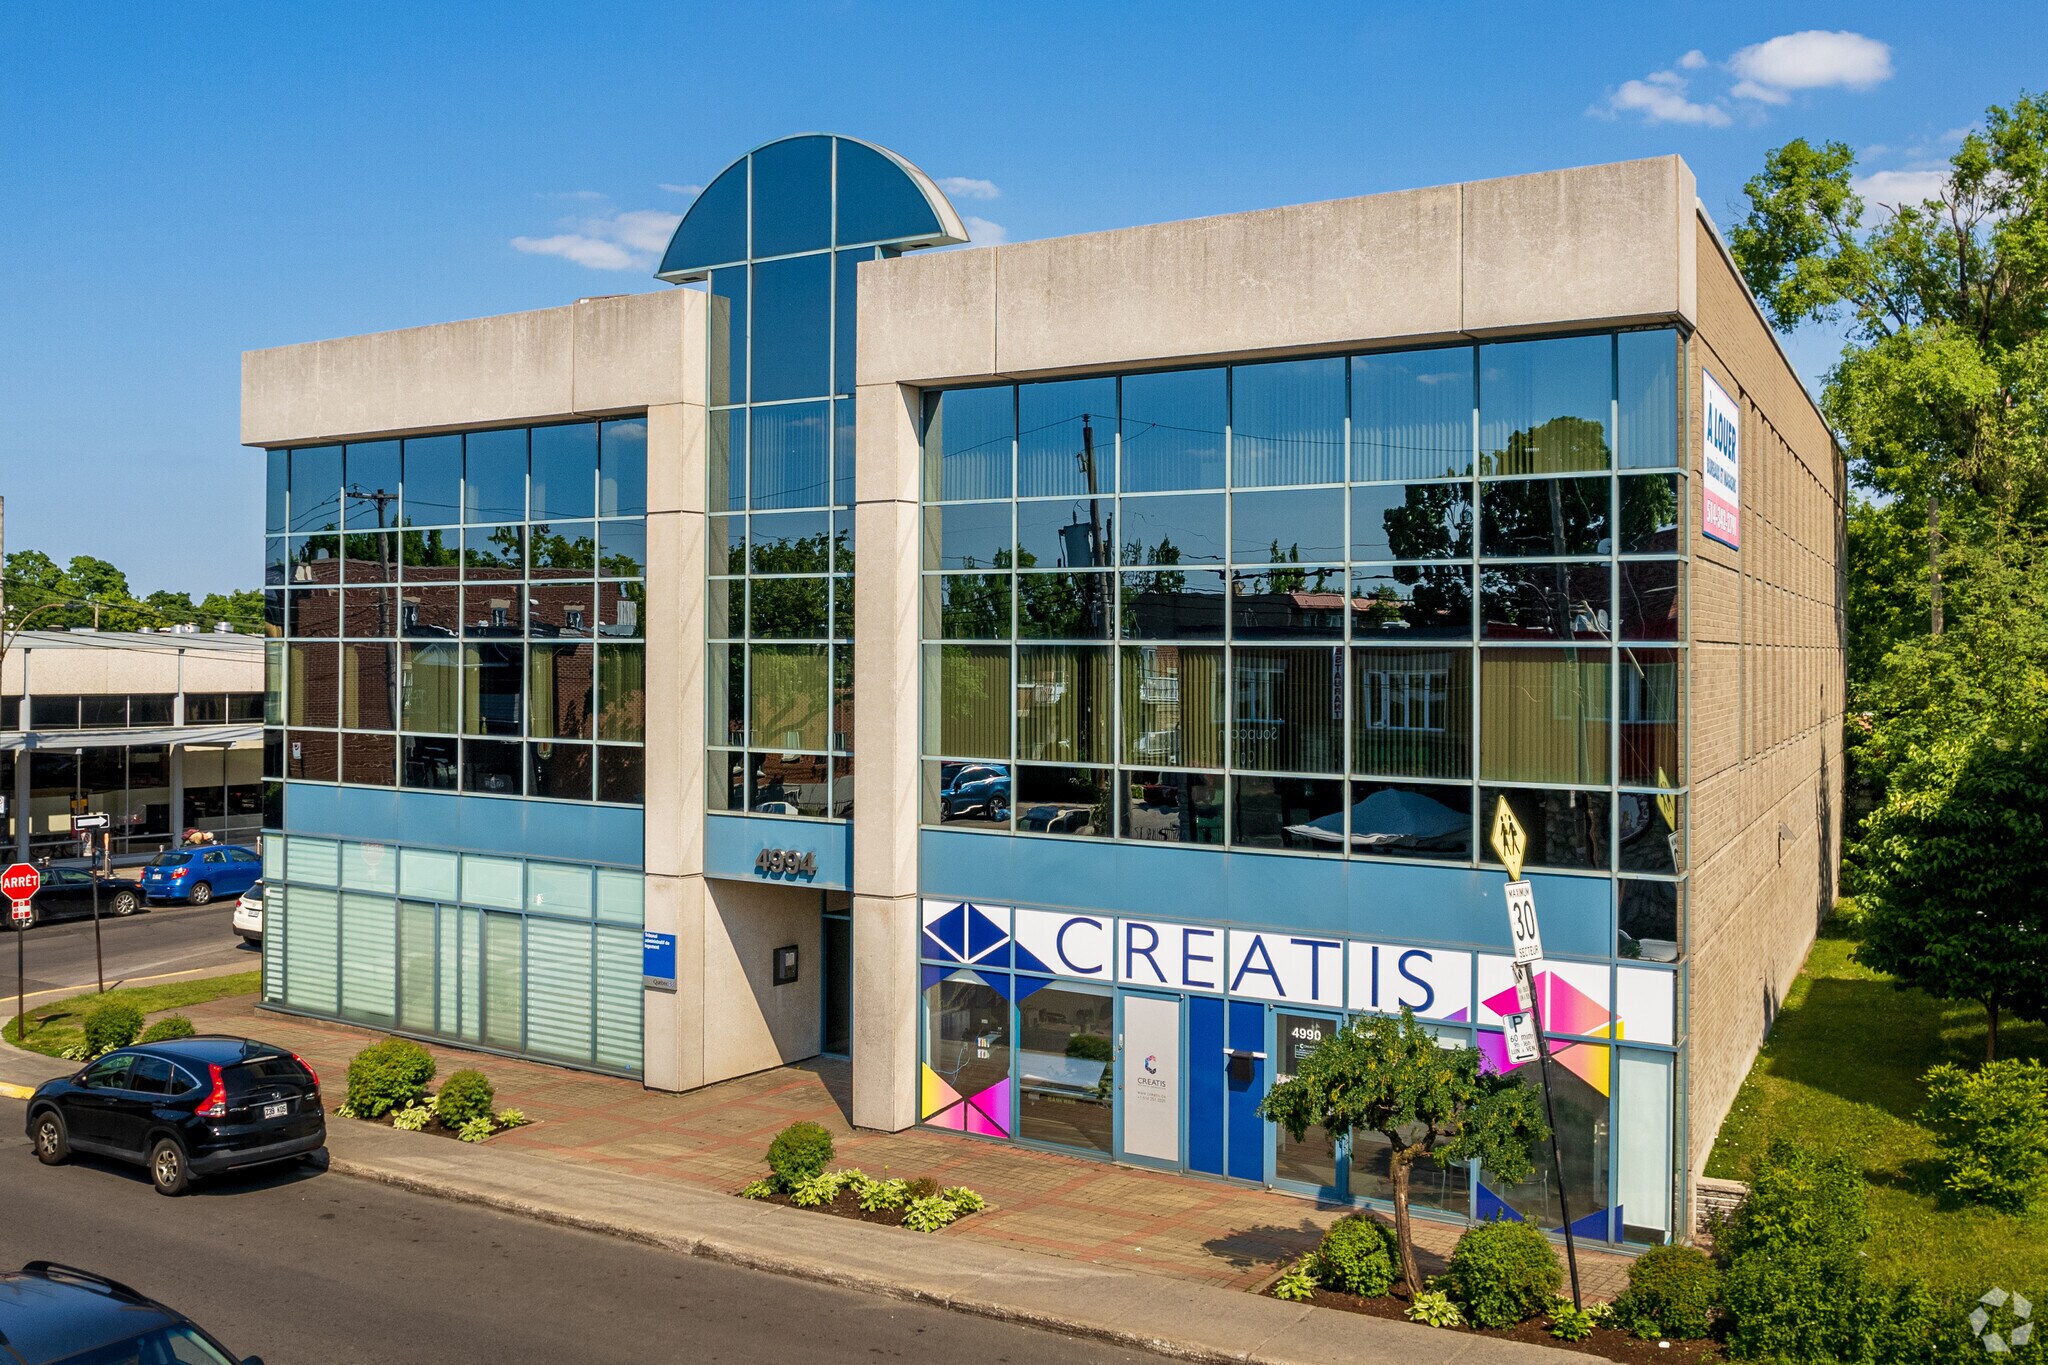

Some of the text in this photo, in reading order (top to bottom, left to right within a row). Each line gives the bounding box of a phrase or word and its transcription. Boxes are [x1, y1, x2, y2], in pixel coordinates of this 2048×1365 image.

[1714, 408, 1737, 464] LOUER
[755, 848, 818, 876] 4994
[3, 873, 38, 889] ARRÊT
[1508, 887, 1530, 897] MAXIMUM
[1513, 900, 1535, 941] 30
[1056, 916, 1435, 1013] CREATIS
[1512, 1015, 1523, 1033] P
[1291, 1027, 1321, 1041] 4990
[1510, 1034, 1519, 1043] 60
[1137, 1077, 1167, 1088] CREATIS
